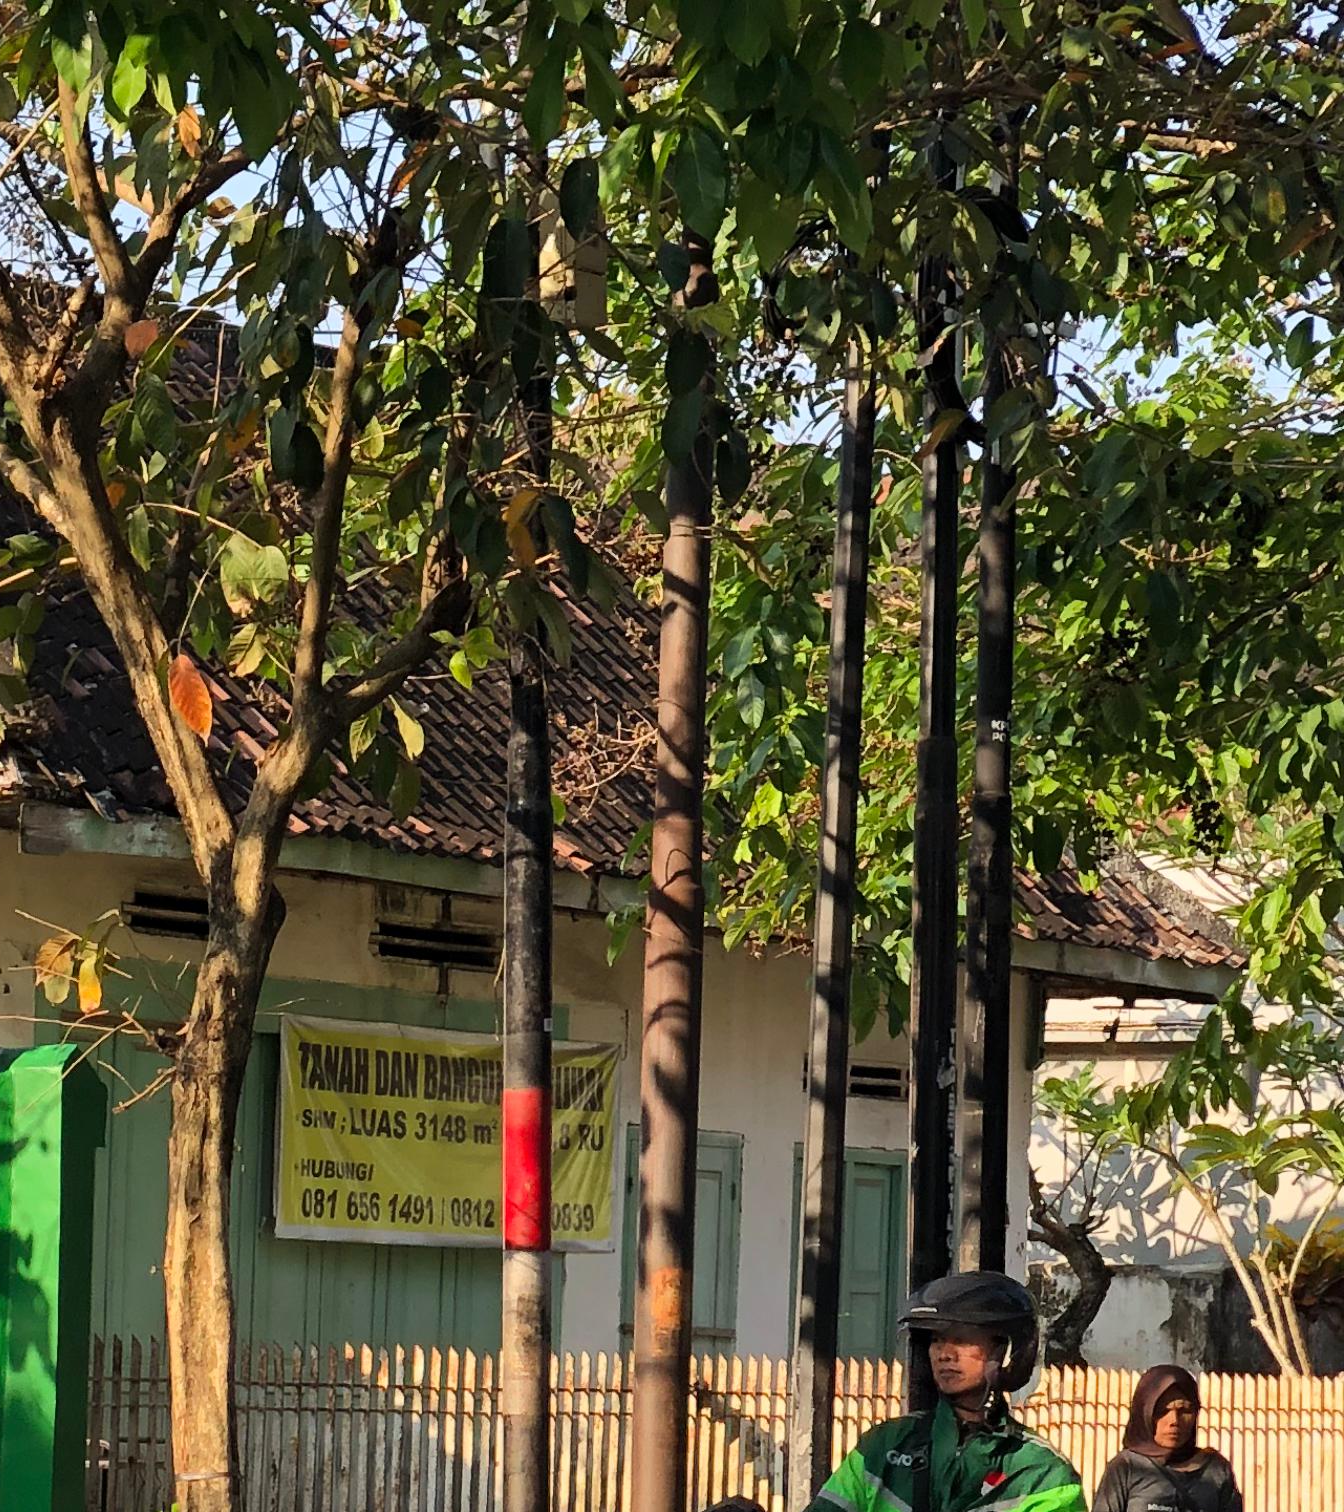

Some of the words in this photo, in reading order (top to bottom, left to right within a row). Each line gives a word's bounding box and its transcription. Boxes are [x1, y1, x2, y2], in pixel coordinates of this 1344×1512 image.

[298, 1041, 369, 1095] TANAH
[374, 1049, 418, 1099] DAN
[349, 1107, 407, 1139] LUAS
[414, 1111, 466, 1143] 3148
[577, 1123, 604, 1151] RU
[300, 1158, 374, 1182] HUBUNGI
[301, 1188, 338, 1219] 081
[346, 1191, 381, 1222] 656
[388, 1194, 434, 1225] 1491
[450, 1197, 496, 1228] 0812
